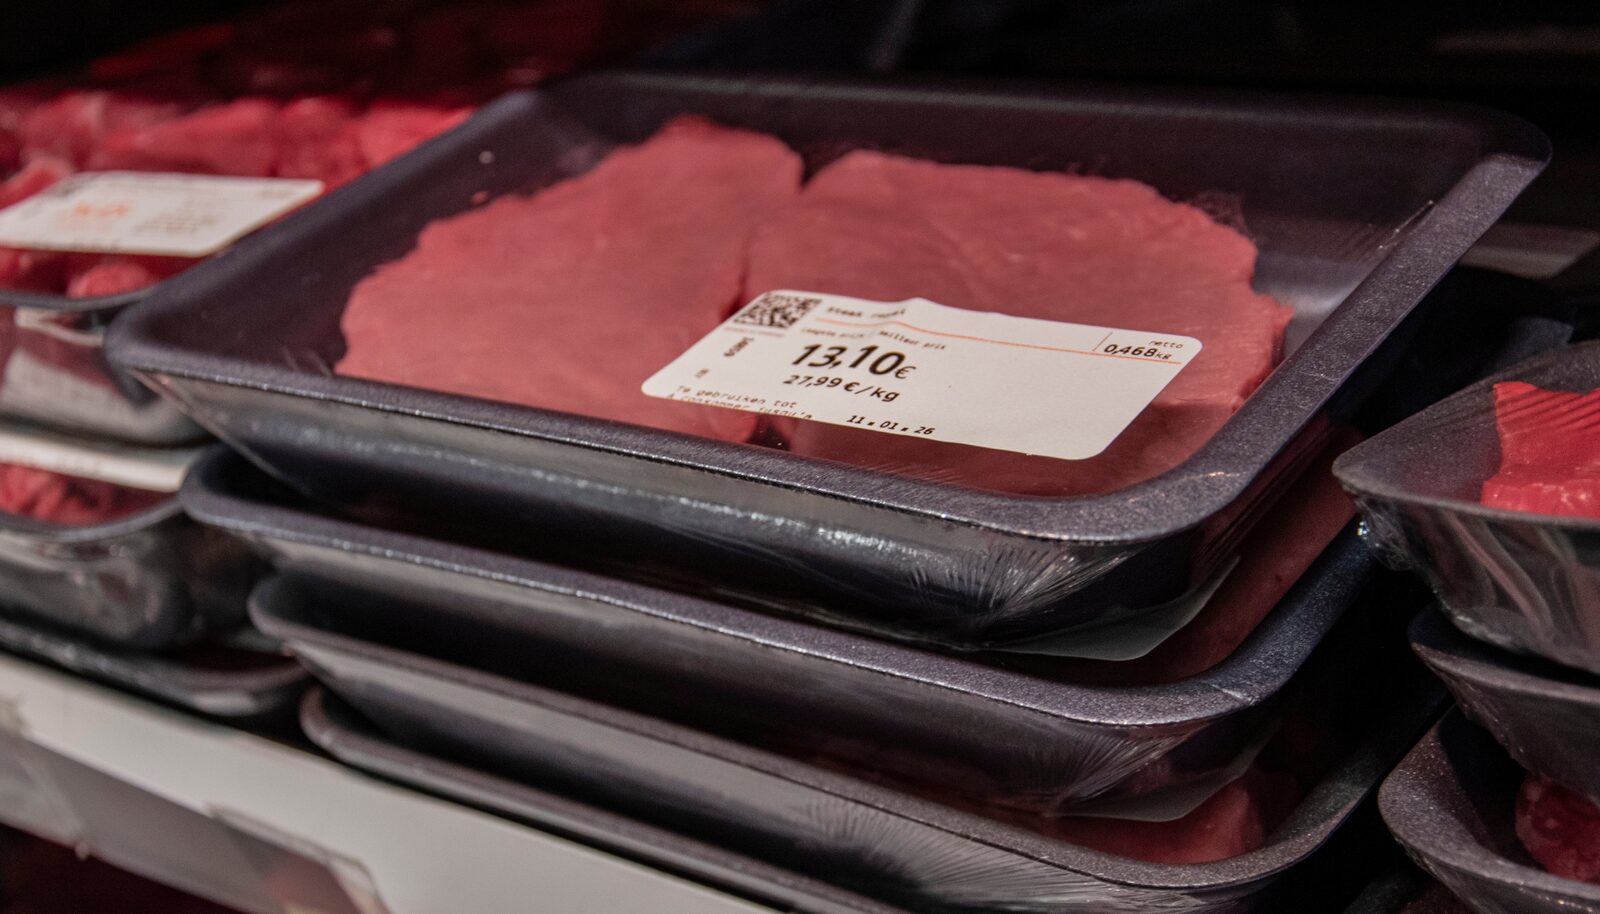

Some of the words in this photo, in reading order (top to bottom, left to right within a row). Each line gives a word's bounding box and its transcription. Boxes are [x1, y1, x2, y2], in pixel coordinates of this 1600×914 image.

[1149, 340, 1184, 349] netto
[792, 344, 918, 380] 13,10€
[676, 385, 692, 393] Te
[696, 389, 767, 405] gebruiken
[774, 400, 799, 409] tot
